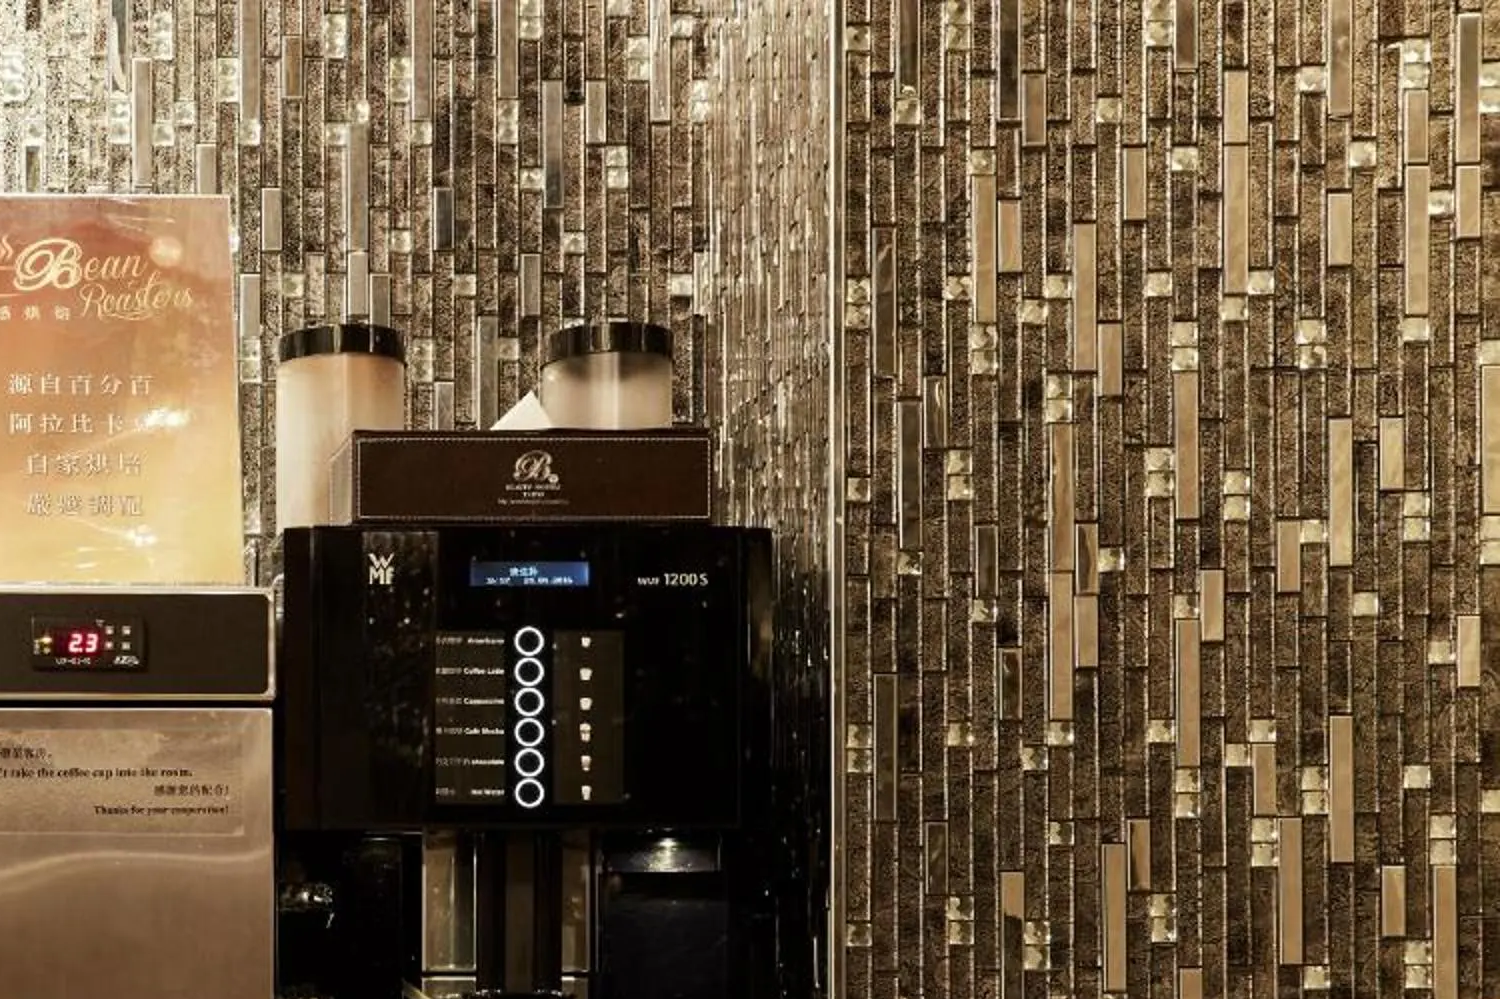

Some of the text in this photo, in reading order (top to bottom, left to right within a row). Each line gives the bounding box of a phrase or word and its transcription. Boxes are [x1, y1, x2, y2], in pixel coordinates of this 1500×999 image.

[14, 237, 148, 291] Bean
[79, 270, 193, 321] Roasters
[7, 373, 155, 396] 源自百分百
[8, 412, 156, 435] 阿拉比卡
[10, 768, 35, 778] take
[37, 767, 55, 778] the
[57, 767, 90, 778] coffee
[92, 768, 113, 780] cup
[115, 768, 137, 778] into
[140, 768, 158, 778] the
[94, 804, 129, 815] Thanks
[131, 804, 145, 815] for
